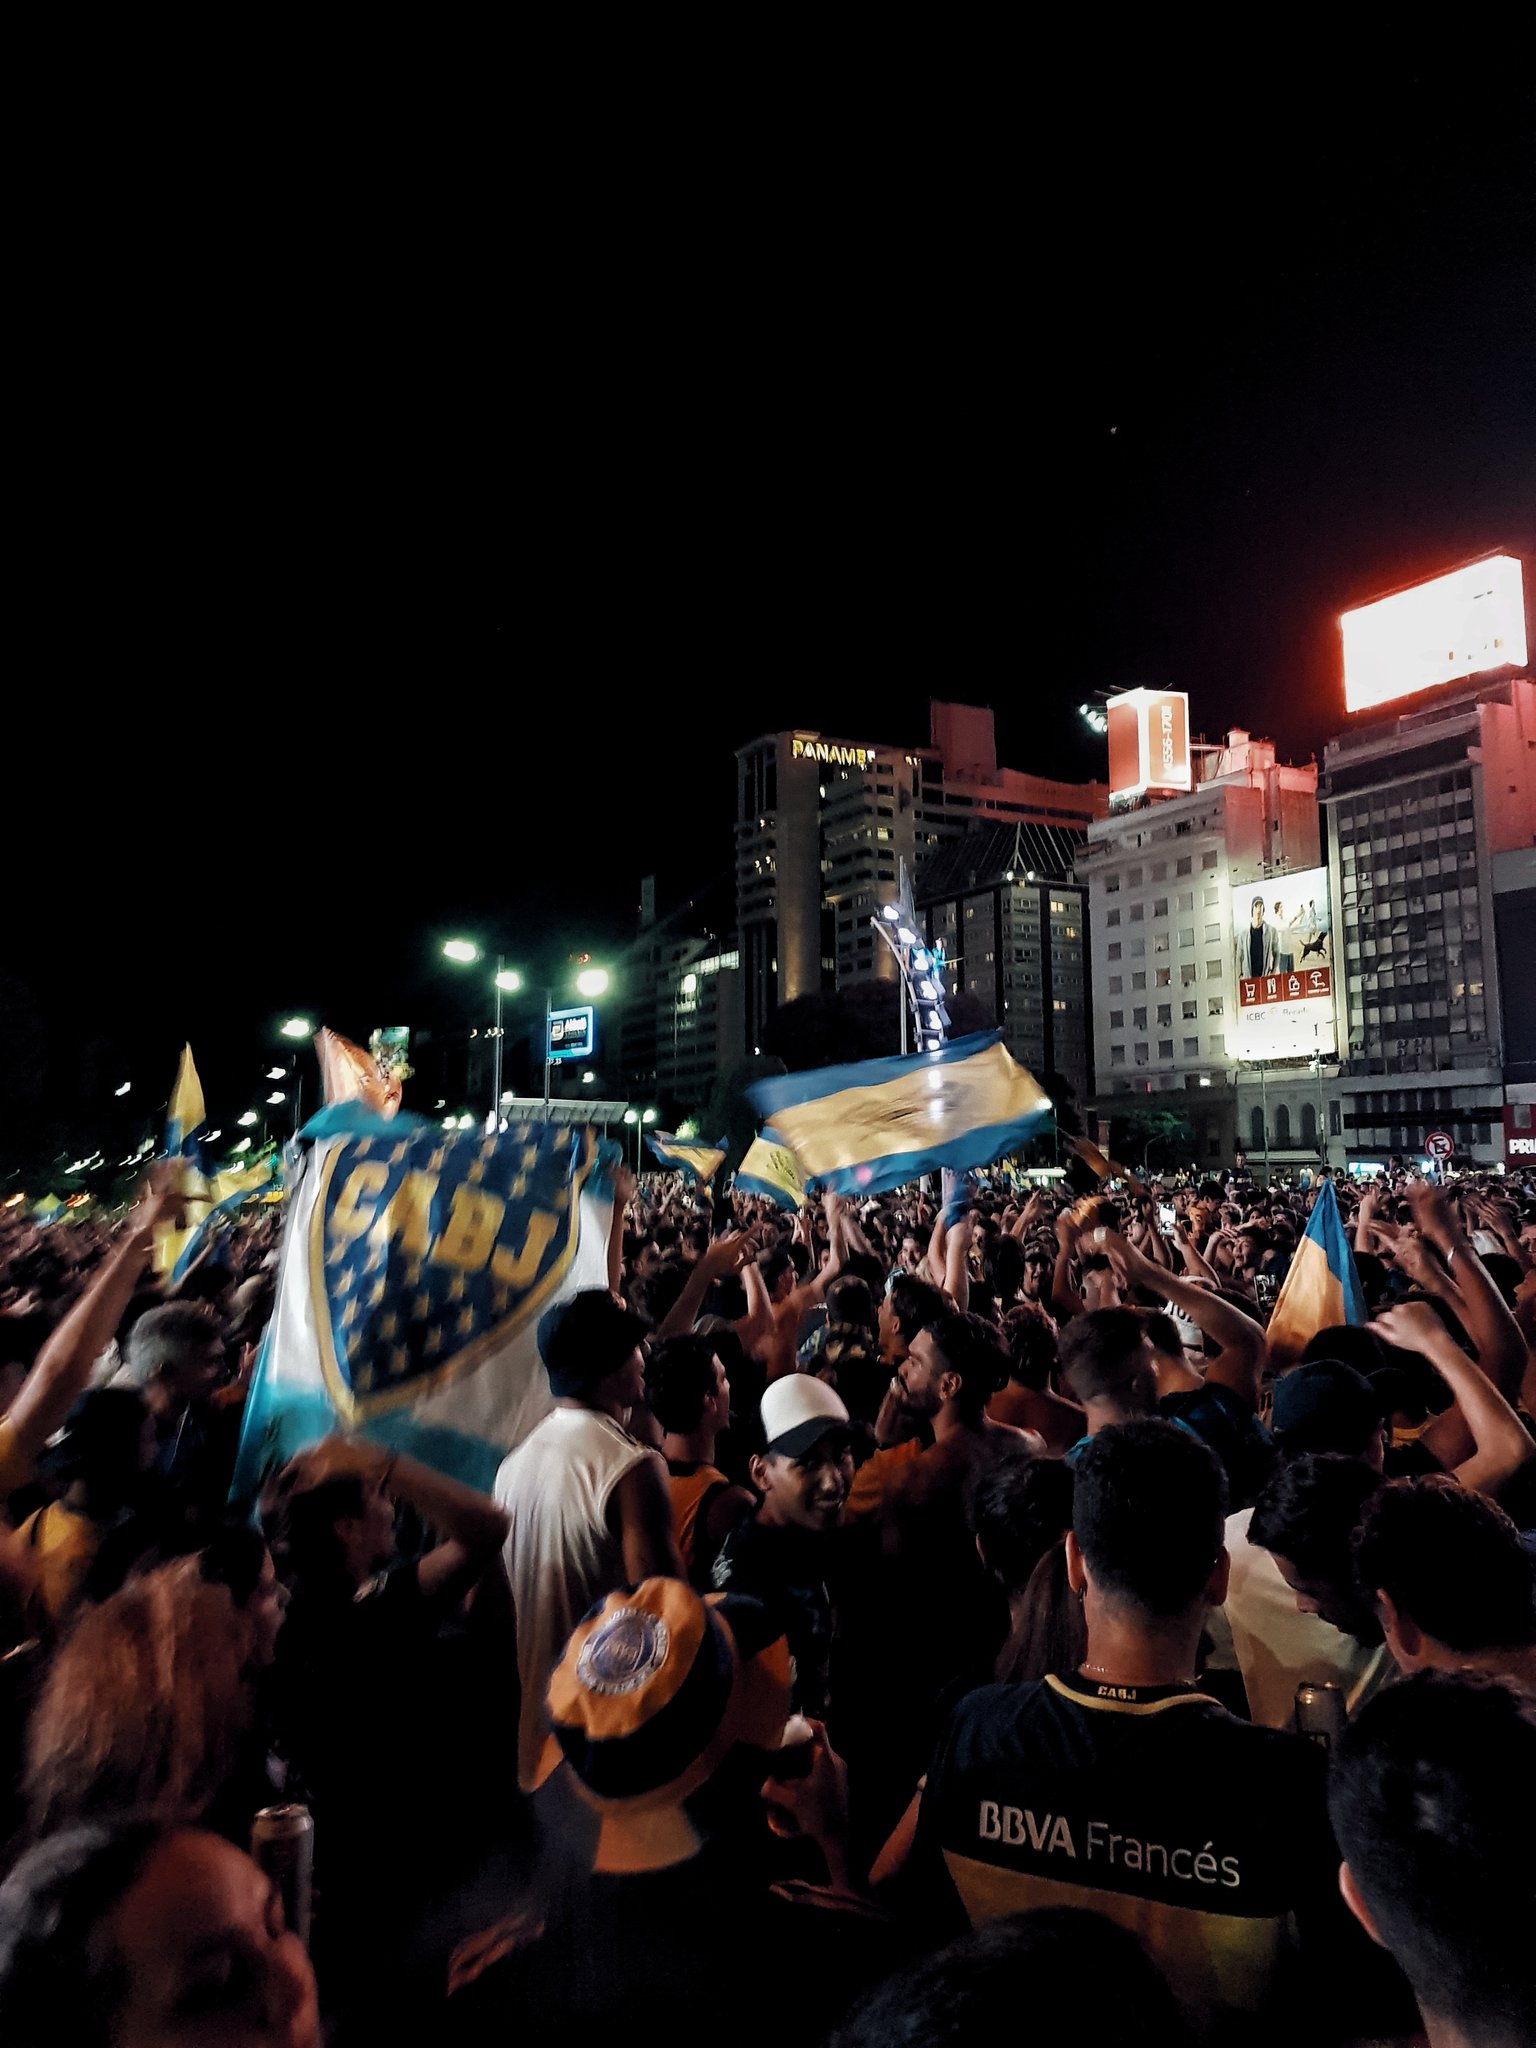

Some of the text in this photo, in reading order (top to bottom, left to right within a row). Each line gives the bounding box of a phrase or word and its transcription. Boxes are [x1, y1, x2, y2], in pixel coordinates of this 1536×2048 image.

[1246, 1011, 1266, 1021] ICBC
[327, 1160, 560, 1288] CABJ
[1097, 1685, 1137, 1700] CABJ
[979, 1800, 1240, 1887] BBVA Francés
